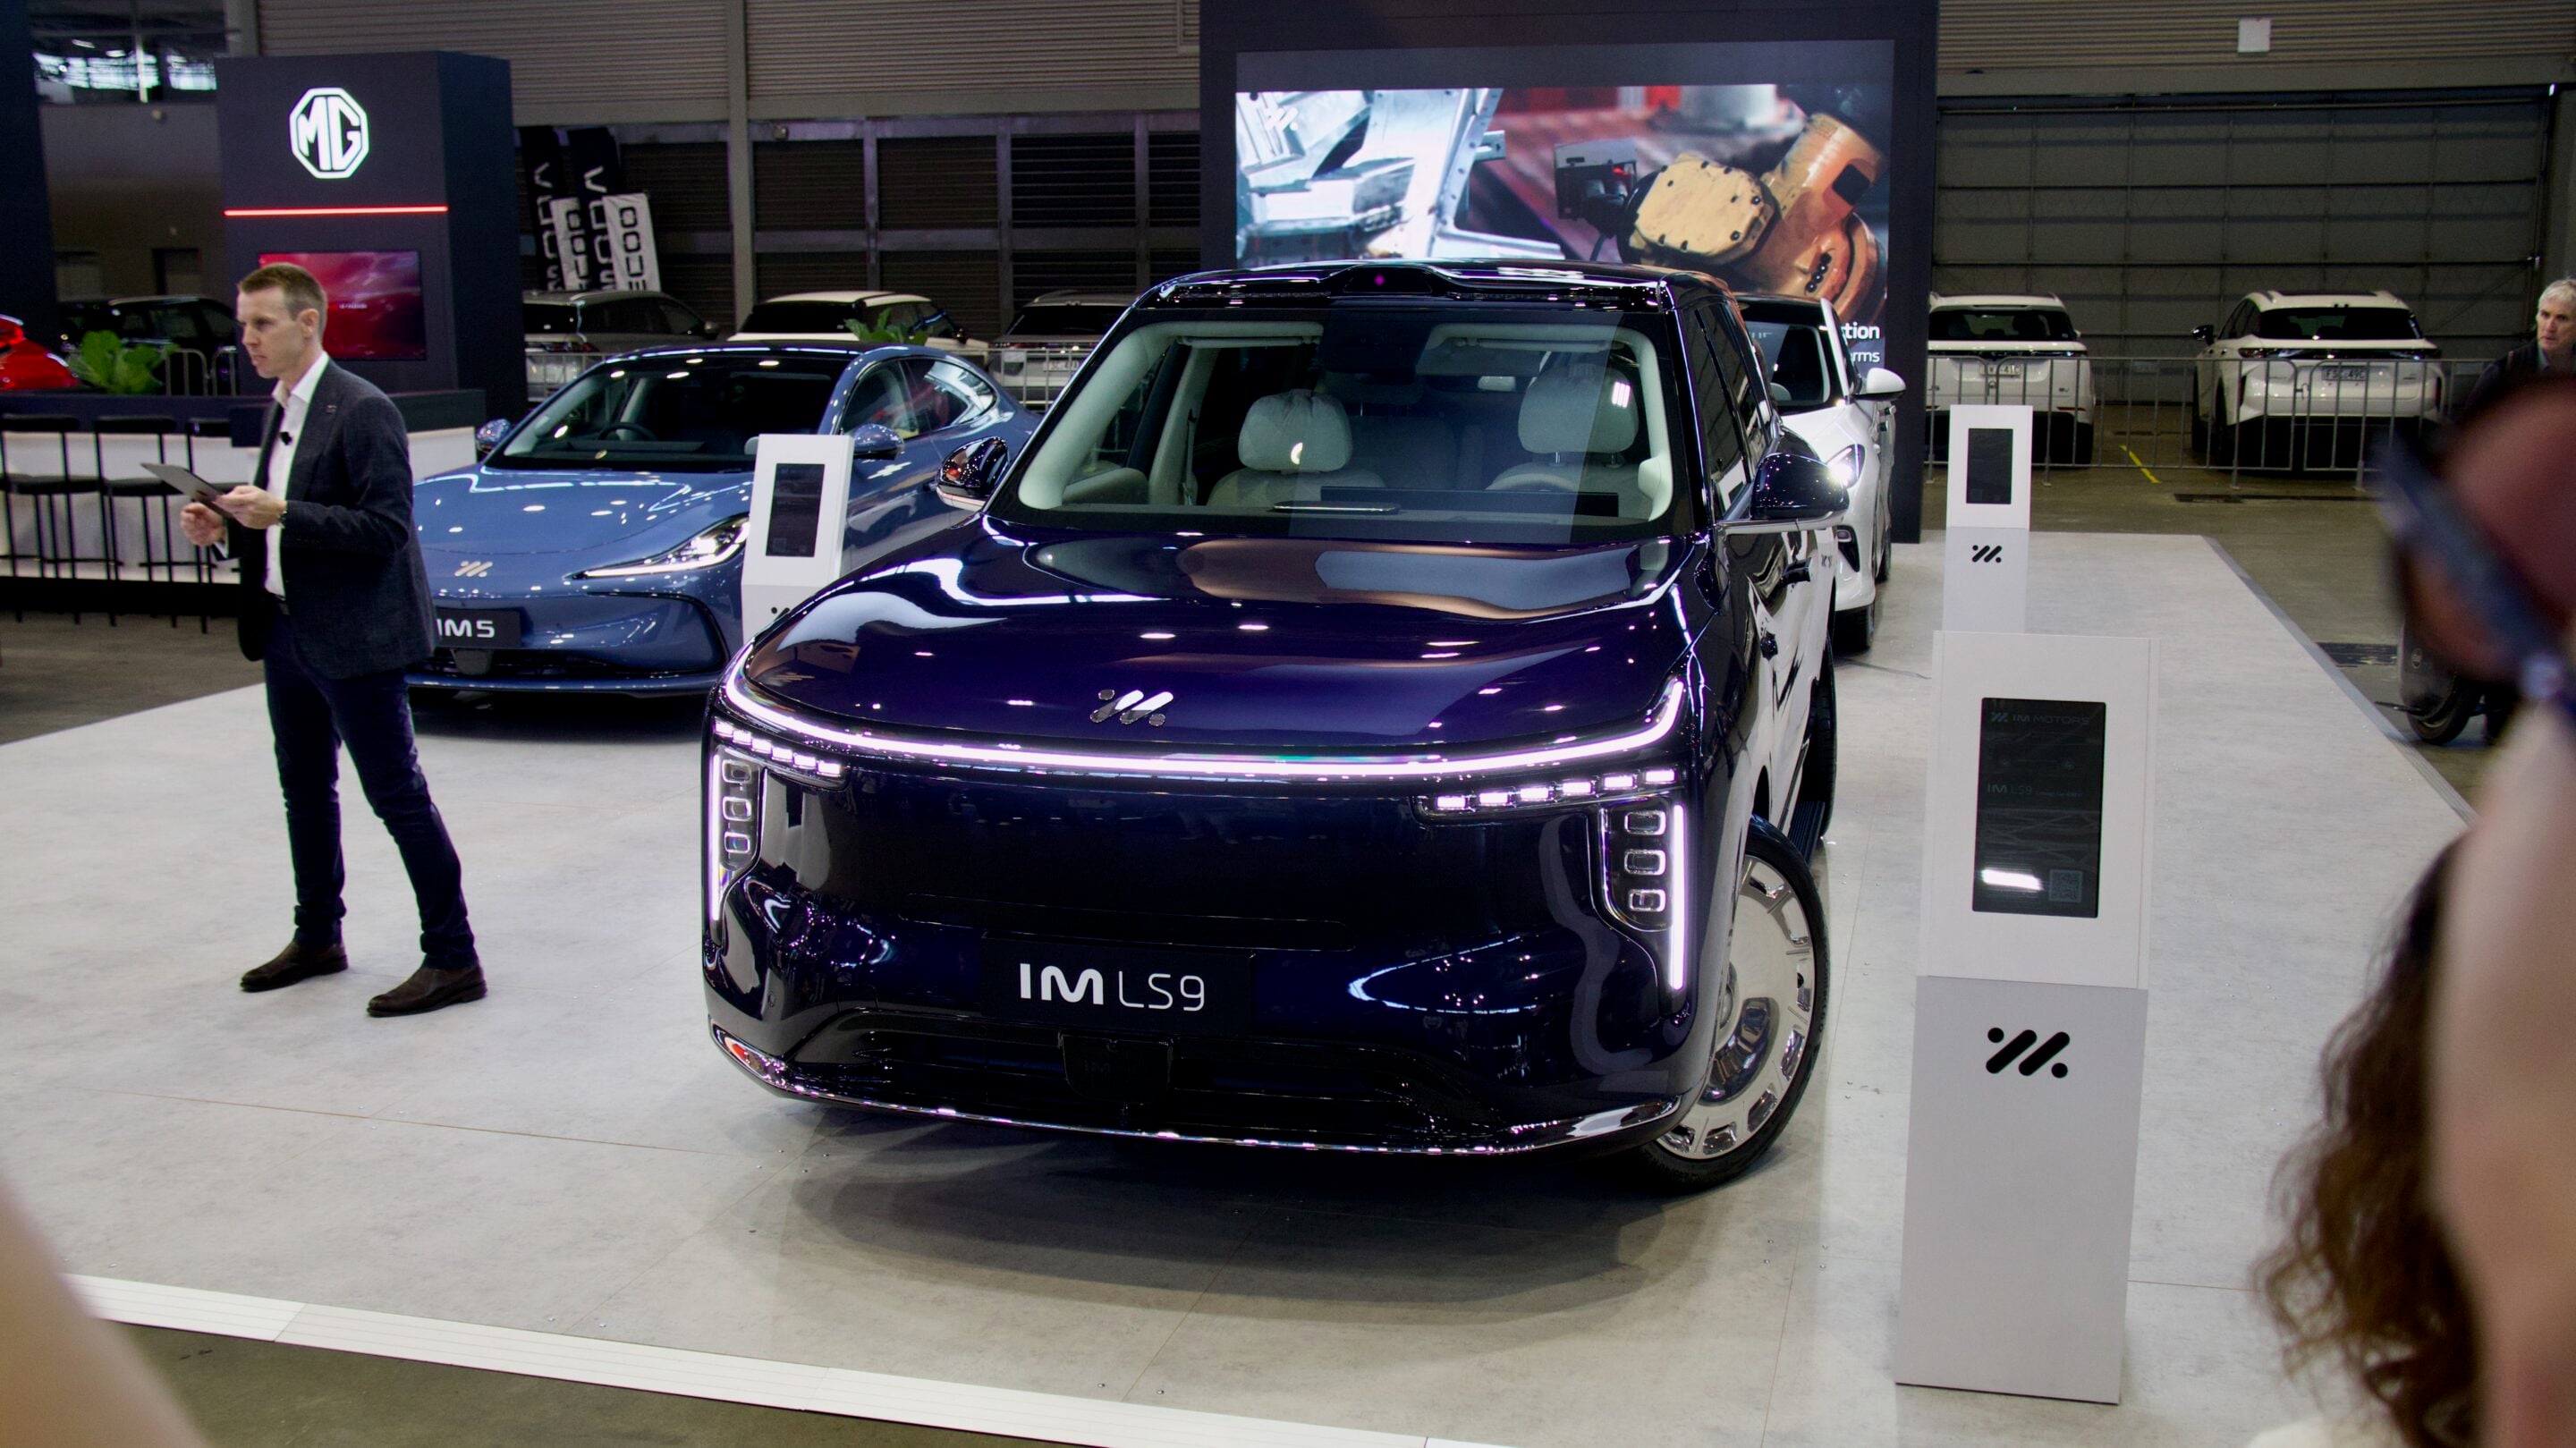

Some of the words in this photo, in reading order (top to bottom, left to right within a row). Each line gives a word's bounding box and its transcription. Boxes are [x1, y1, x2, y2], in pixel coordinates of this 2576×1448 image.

[296, 96, 362, 172] MG
[1843, 321, 1880, 340] tion
[1852, 351, 1880, 363] rms
[1020, 963, 1104, 1005] IM
[1118, 970, 1205, 1012] LS9
